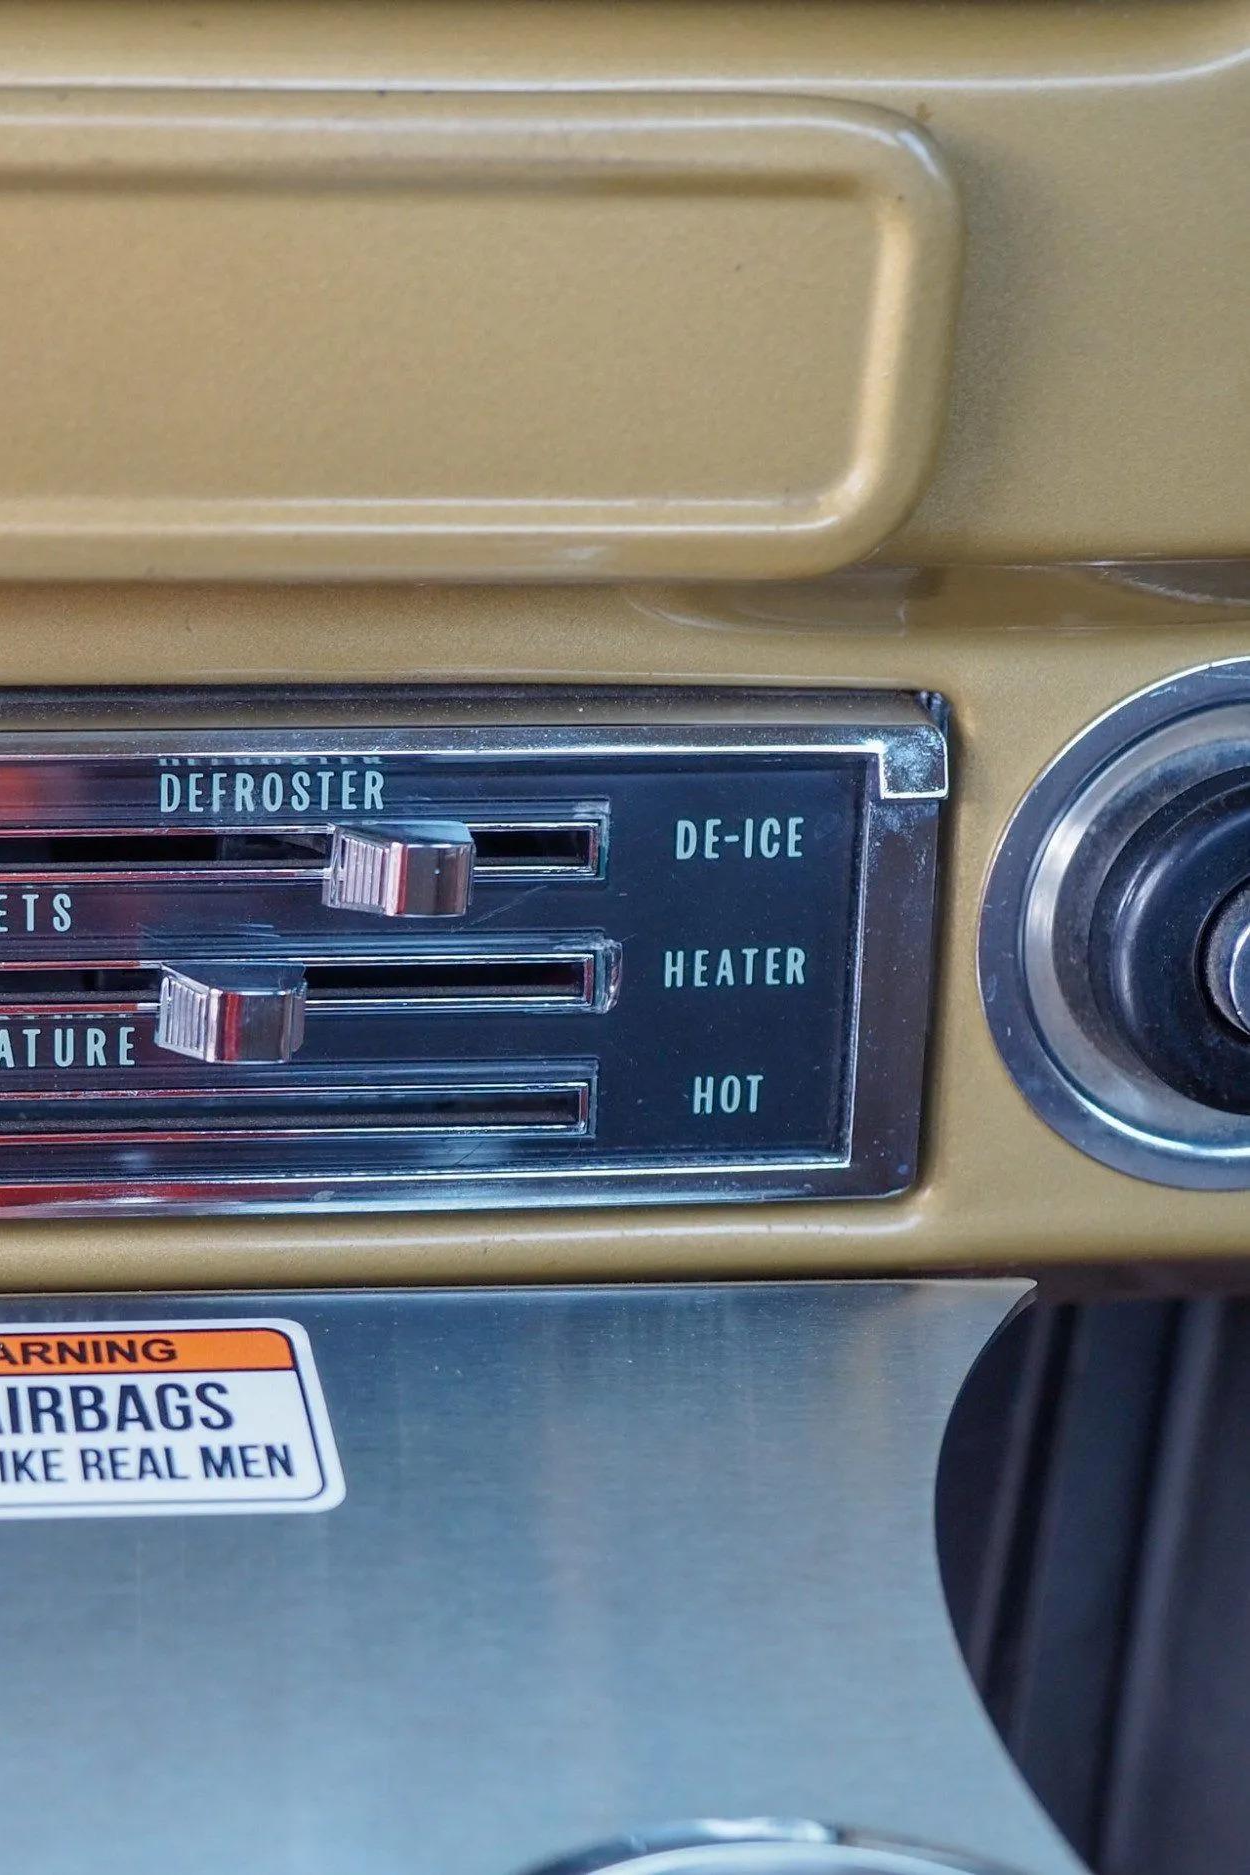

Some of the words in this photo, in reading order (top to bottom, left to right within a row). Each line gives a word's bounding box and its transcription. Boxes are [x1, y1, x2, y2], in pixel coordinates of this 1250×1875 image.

[159, 770, 385, 813] DEFROSTER
[675, 816, 805, 860] DE-ICE
[664, 946, 807, 988] HEATER
[693, 1075, 764, 1114] HOT
[81, 1446, 189, 1482] REAL
[199, 1443, 296, 1480] MEN
